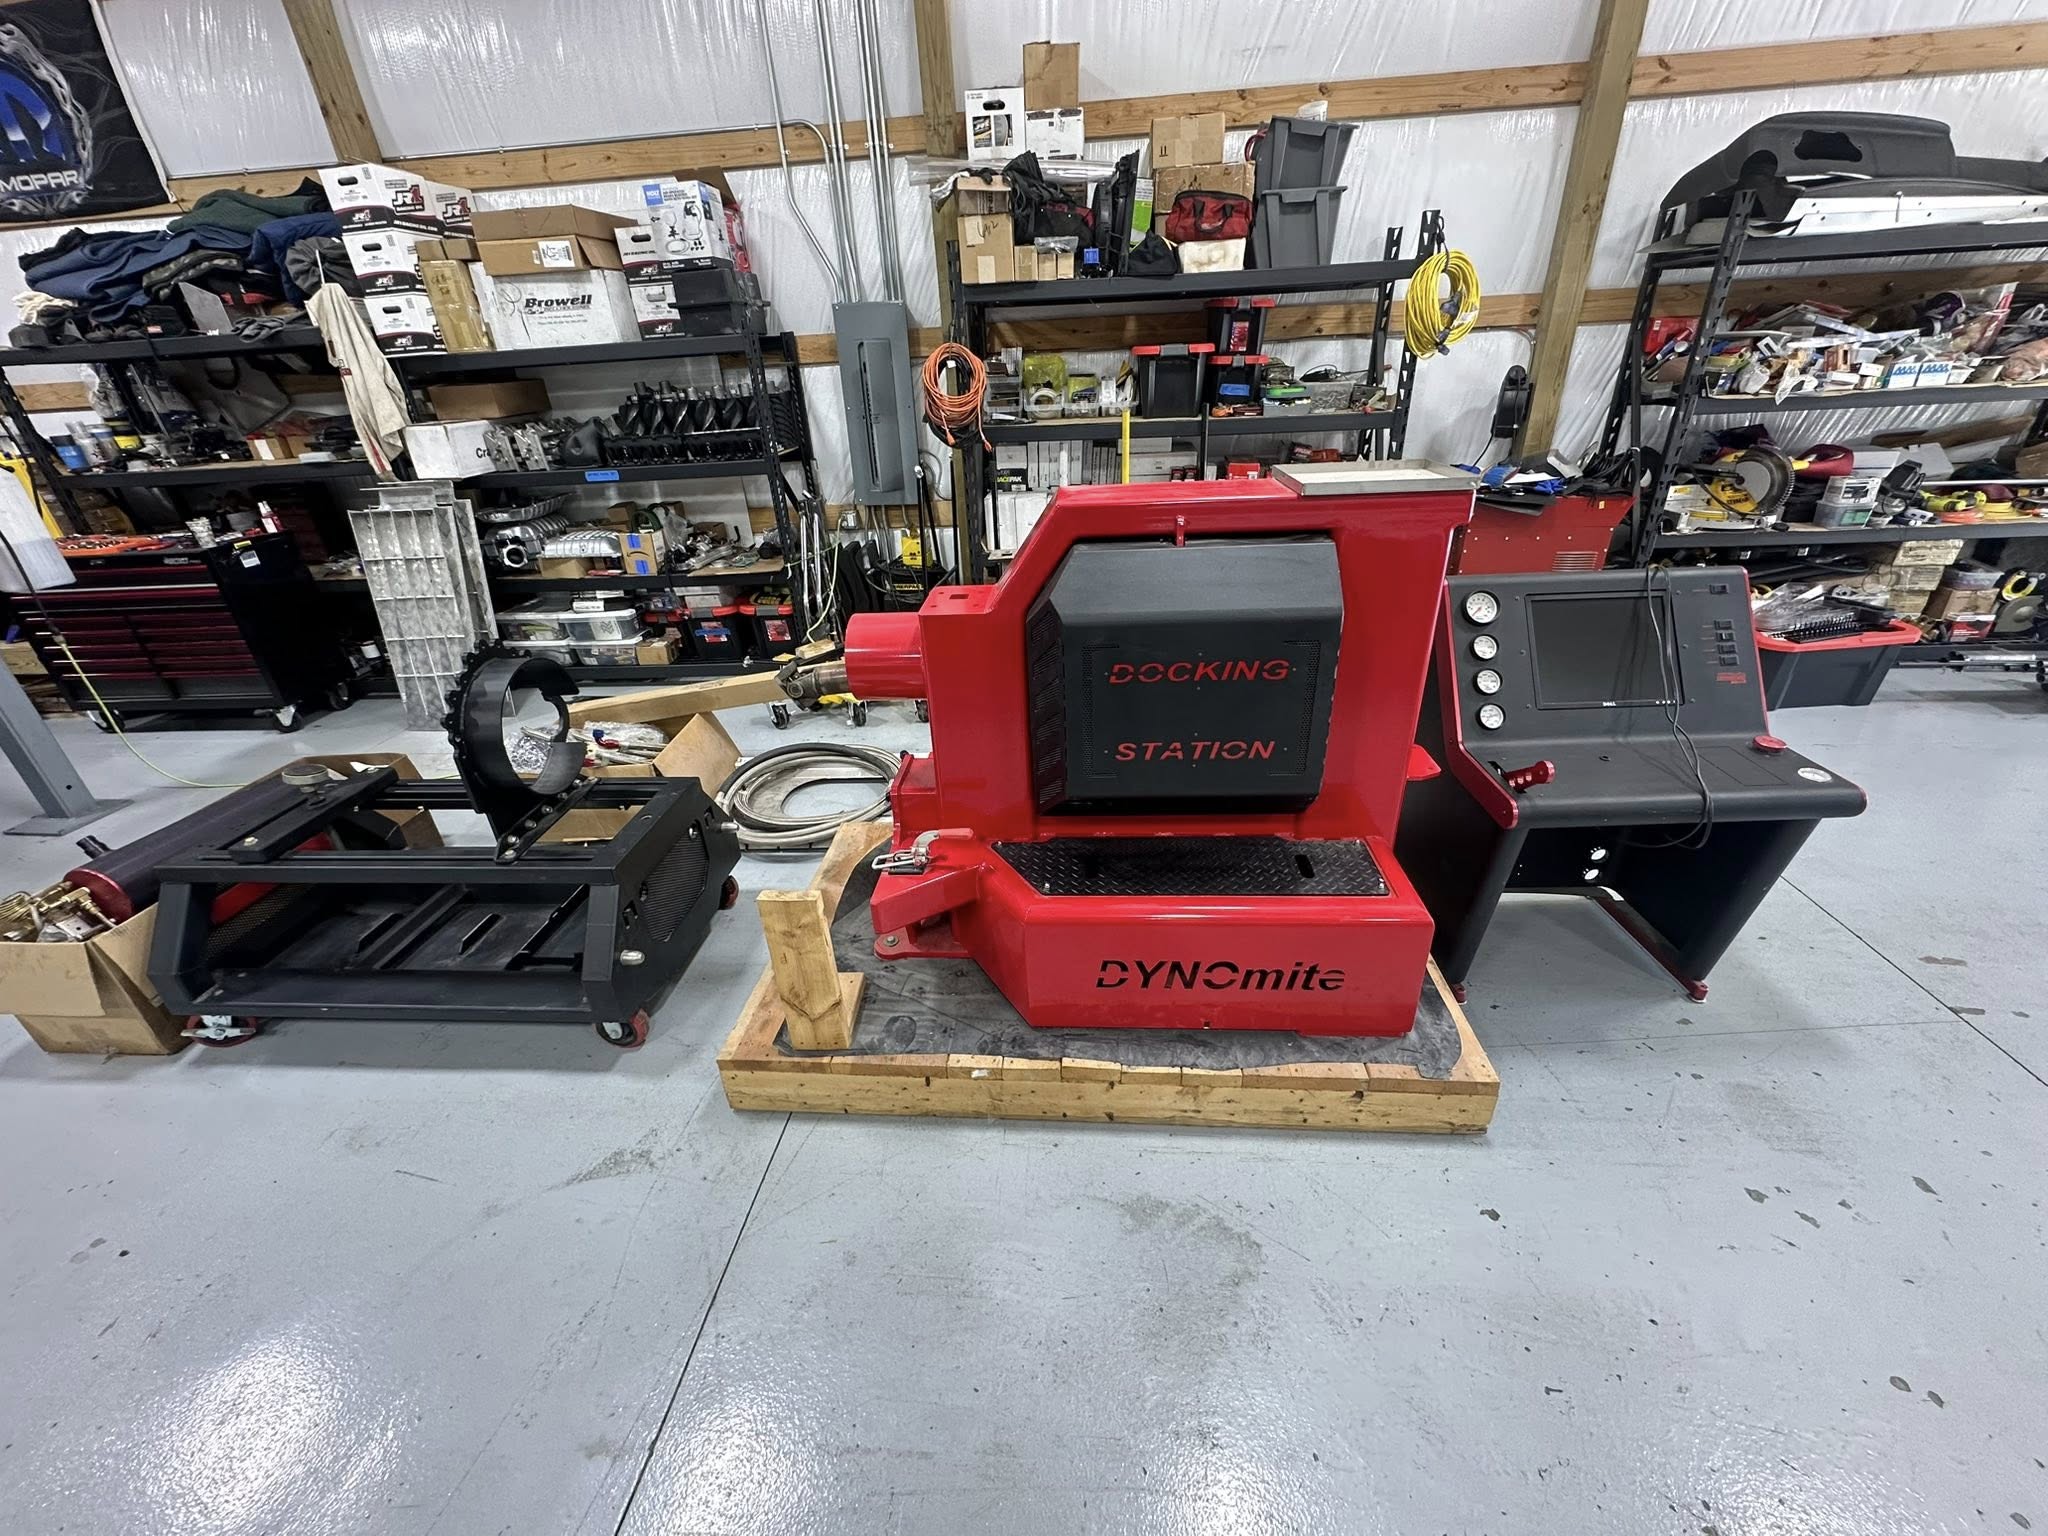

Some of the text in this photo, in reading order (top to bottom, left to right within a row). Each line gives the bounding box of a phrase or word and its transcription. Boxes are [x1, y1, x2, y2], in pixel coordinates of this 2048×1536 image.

[0, 170, 79, 193] MOPAR
[393, 186, 423, 206] JR1
[525, 294, 592, 308] Browell
[1109, 659, 1291, 685] DOCKING
[1115, 740, 1276, 761] STATION
[1096, 959, 1345, 991] DYNOmite
